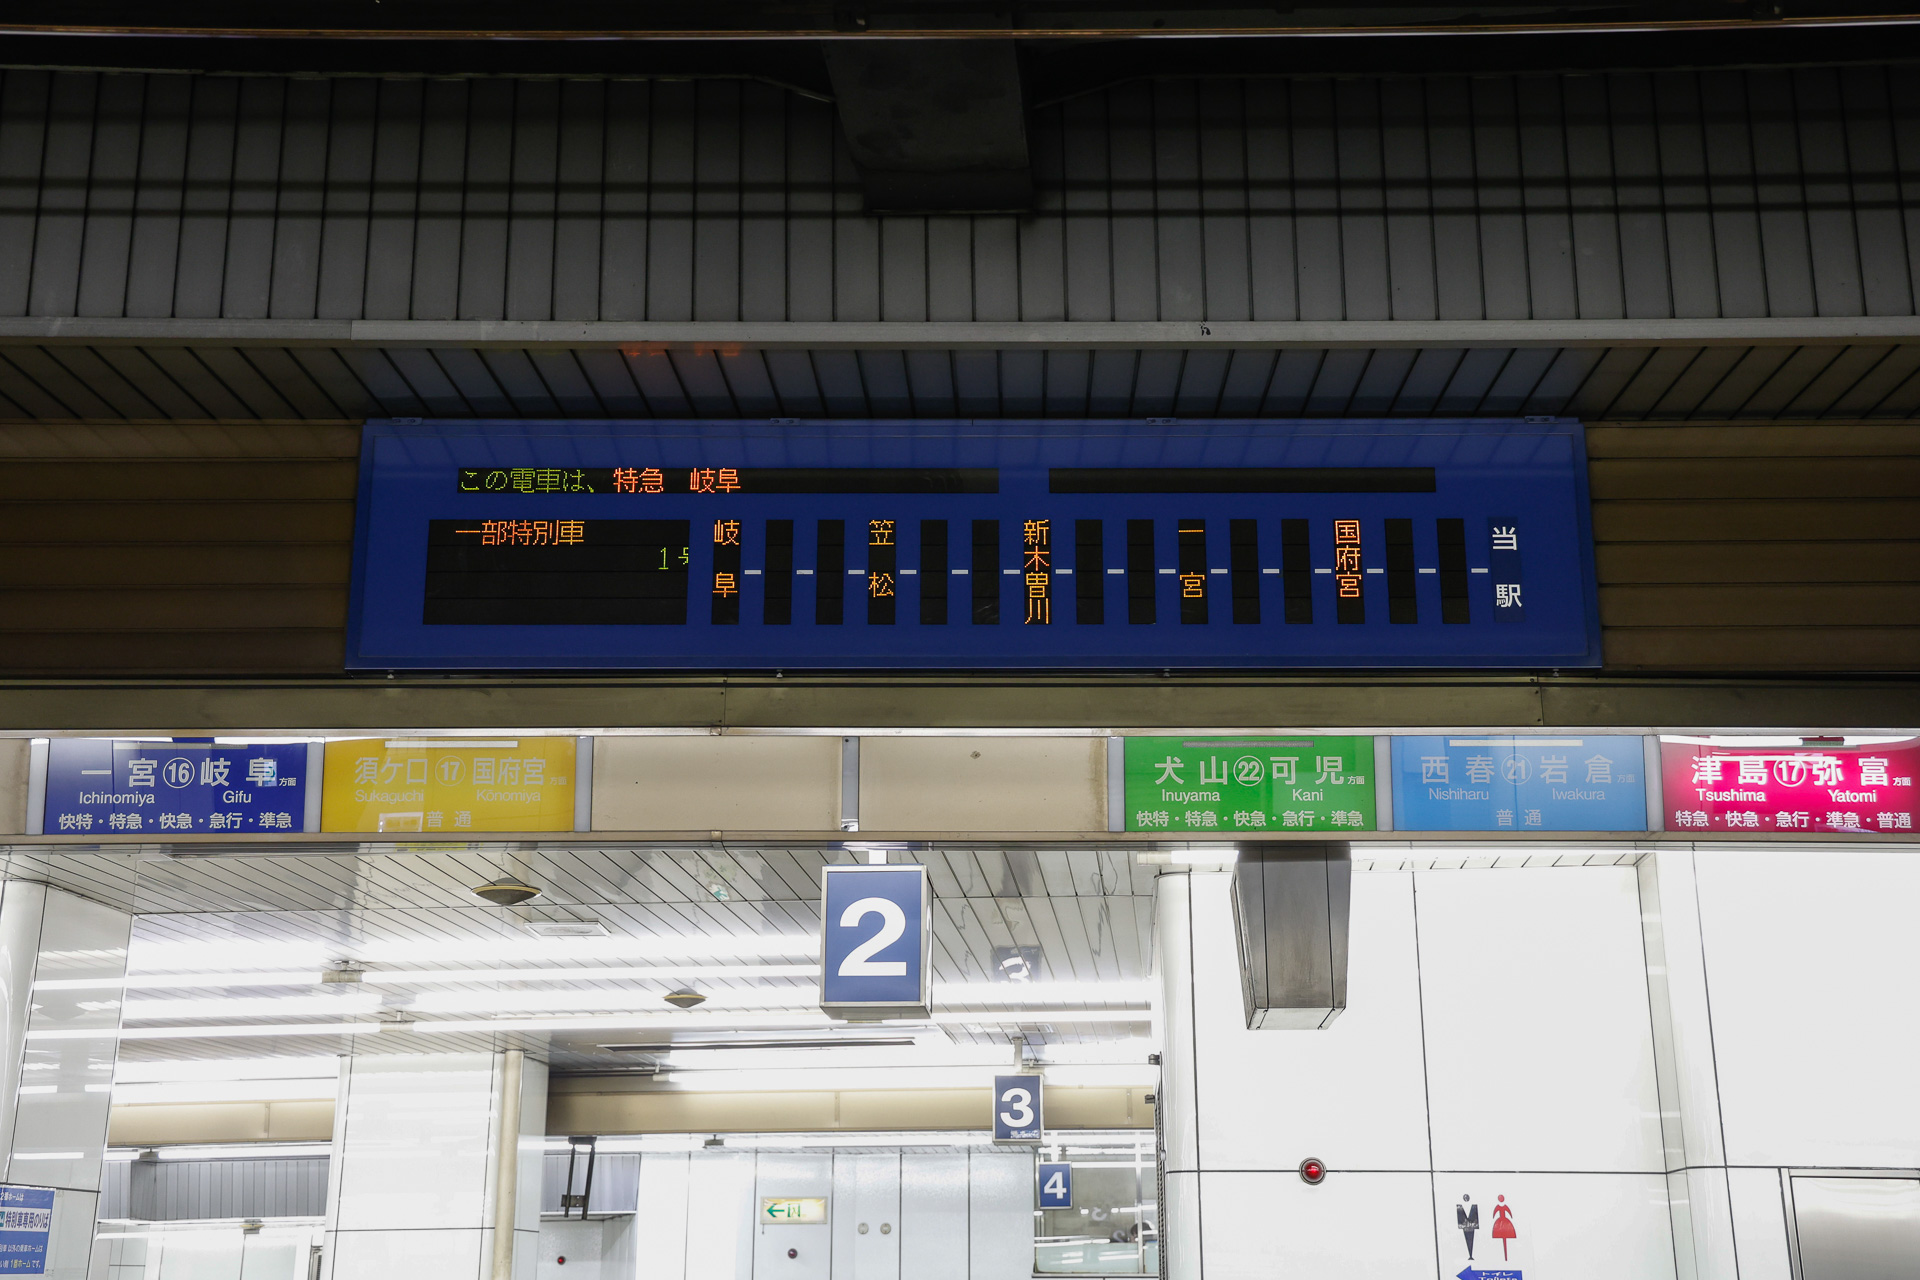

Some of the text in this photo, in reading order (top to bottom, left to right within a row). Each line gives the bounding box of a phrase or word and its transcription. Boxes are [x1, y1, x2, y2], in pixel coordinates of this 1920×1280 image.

[460, 467, 741, 493] この電車は、 特急 岐阜
[455, 519, 585, 545] 一部特別車
[713, 519, 740, 598] 岐阜
[868, 519, 895, 598] 笠松
[1023, 519, 1050, 625] 新木曽川
[1178, 529, 1205, 598] 一宮
[1334, 519, 1361, 598] 国府宮
[1492, 526, 1523, 608] 当駅
[81, 757, 158, 788] 一宮
[200, 757, 277, 787] 岐阜
[279, 777, 297, 787] 方面
[472, 757, 546, 785] 国府宮
[550, 776, 568, 786] 方面
[1154, 755, 1228, 785] 犬山
[1270, 755, 1345, 785] 可児
[1347, 775, 1365, 785] 方面
[1421, 754, 1495, 784] 西春
[1540, 754, 1613, 784] 岩倉
[1617, 773, 1636, 783] 方面
[1691, 755, 1768, 785] 津島
[1812, 756, 1889, 787] 弥富
[1893, 776, 1912, 787] 方面
[79, 790, 252, 808] Ichinomiya Gifu
[355, 789, 424, 806] Sukaguchi
[1162, 788, 1324, 805] Inuyama Kani
[1429, 787, 1605, 801] Nishiharu Iwakura
[1695, 788, 1877, 803] Tsushima Yatomi
[426, 810, 472, 828] 普通
[1496, 808, 1542, 826] 普通
[838, 896, 907, 977] 2
[1000, 1087, 1034, 1128] 3
[1043, 1171, 1067, 1199] 4
